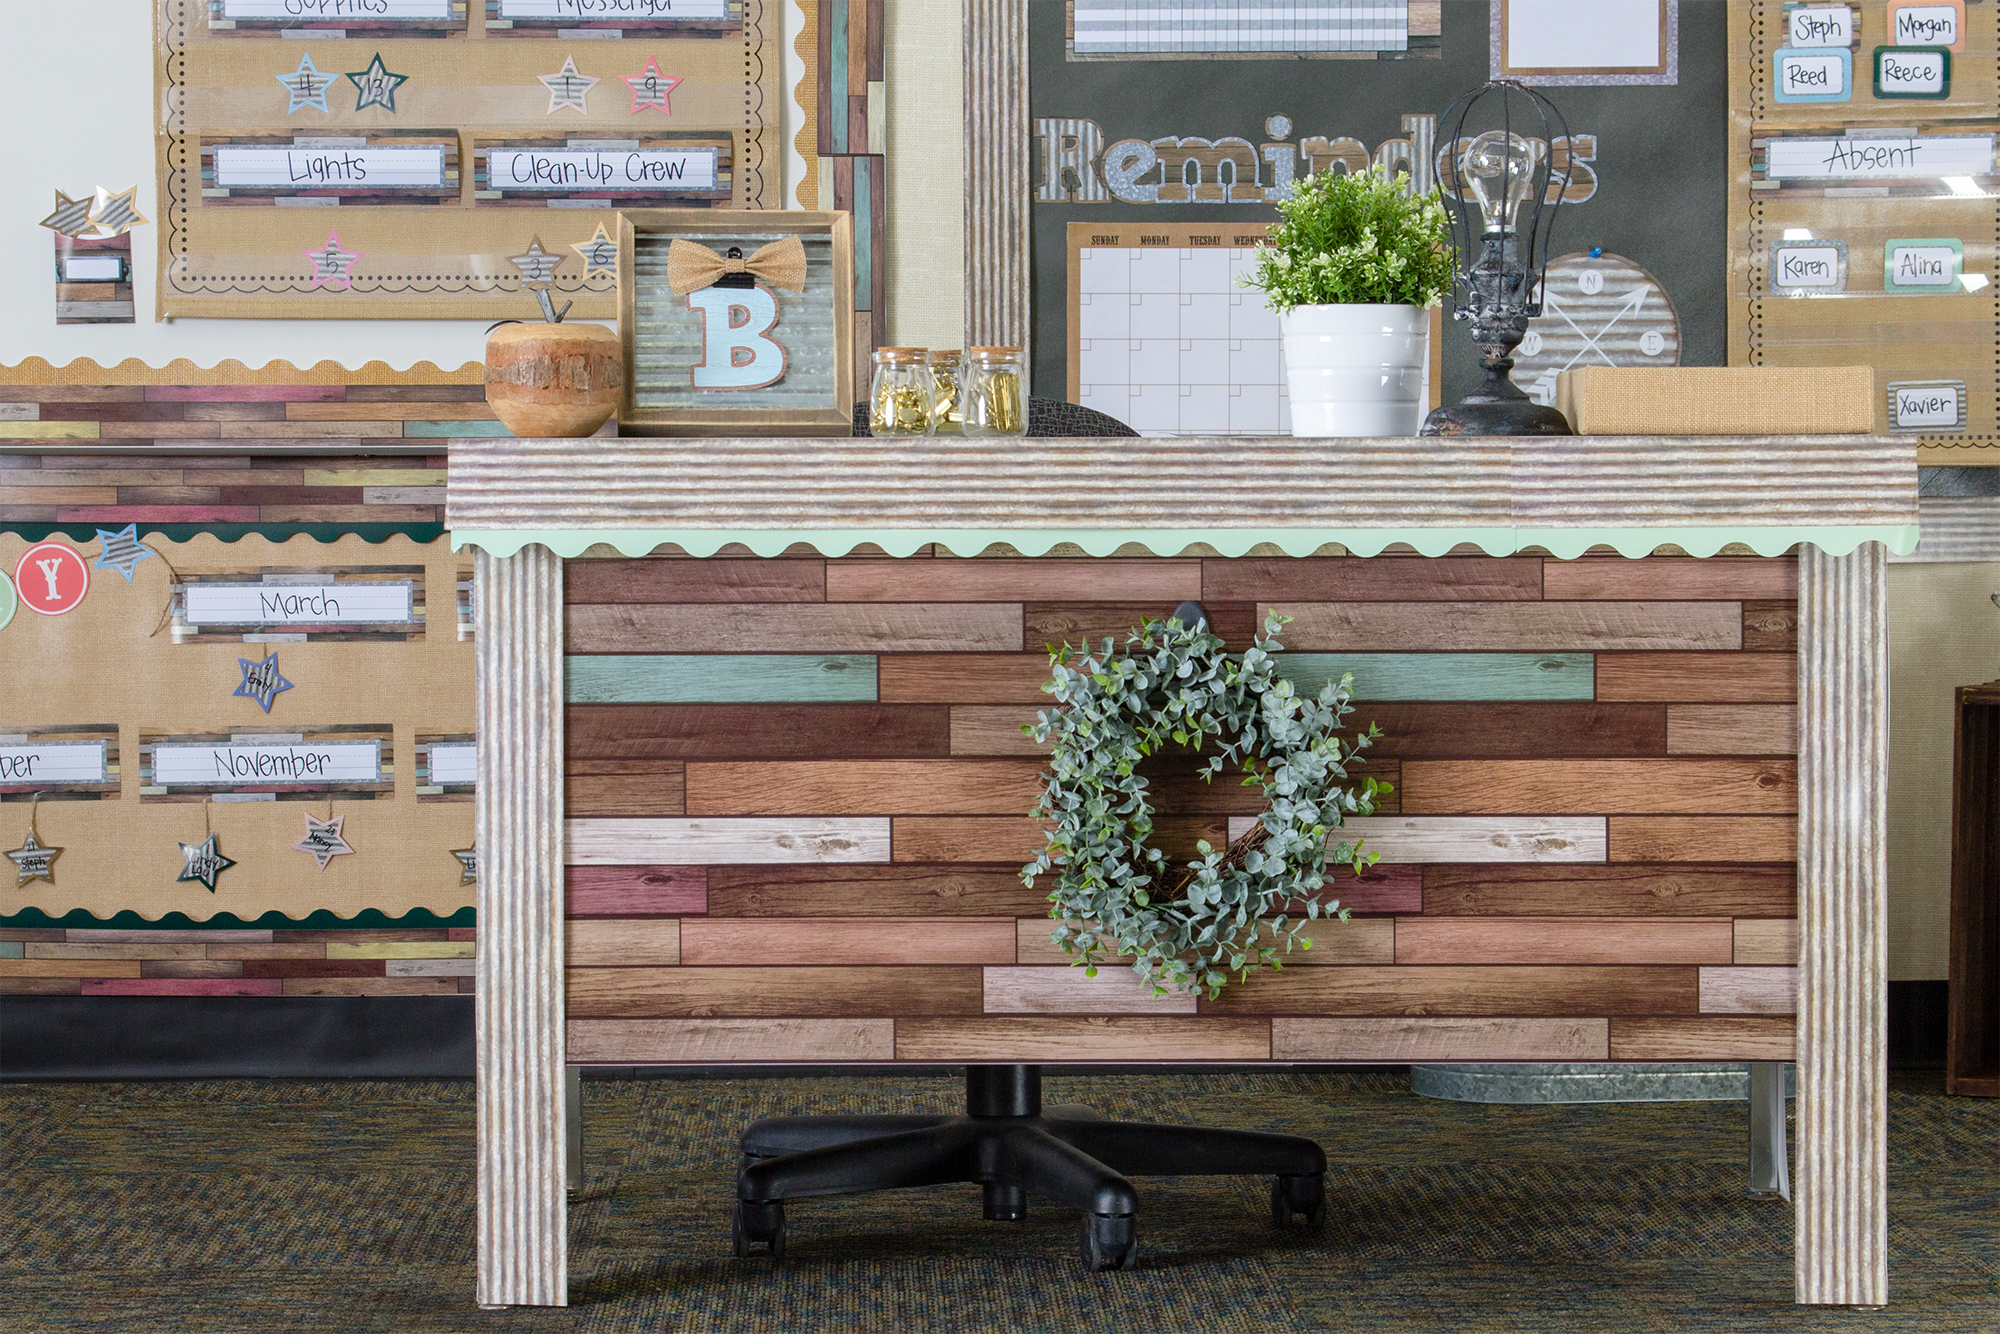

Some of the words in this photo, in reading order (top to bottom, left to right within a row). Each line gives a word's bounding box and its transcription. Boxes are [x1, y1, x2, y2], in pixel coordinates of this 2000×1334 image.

[1795, 14, 1842, 43] Steph
[1899, 13, 1952, 41] Morgan
[1787, 64, 1828, 88] Reed
[1884, 58, 1937, 82] Reece
[300, 73, 315, 97] 4
[367, 77, 384, 97] 13
[644, 76, 657, 99] 9
[287, 151, 367, 183] Lights
[1034, 112, 1598, 205] Remindes
[1822, 138, 1922, 173] Absent
[511, 153, 613, 185] Clean-Up
[625, 152, 687, 182] Crew
[1091, 235, 1120, 246] SUNDAY
[1140, 235, 1170, 246] MONDAY
[1189, 235, 1221, 246] TUESDAY
[325, 253, 339, 274] 5
[593, 244, 609, 265] 6
[1901, 253, 1943, 278] Alina
[530, 258, 543, 280] 3
[1784, 255, 1830, 280] Karen
[1585, 274, 1598, 290] N
[685, 281, 788, 391] B
[1523, 335, 1538, 352] W
[1646, 335, 1658, 351] E
[1899, 394, 1952, 416] Xavier
[36, 557, 63, 601] Y
[260, 588, 341, 619] March
[248, 672, 272, 694] Emily
[213, 747, 331, 779] November
[191, 853, 219, 870] Cindy
